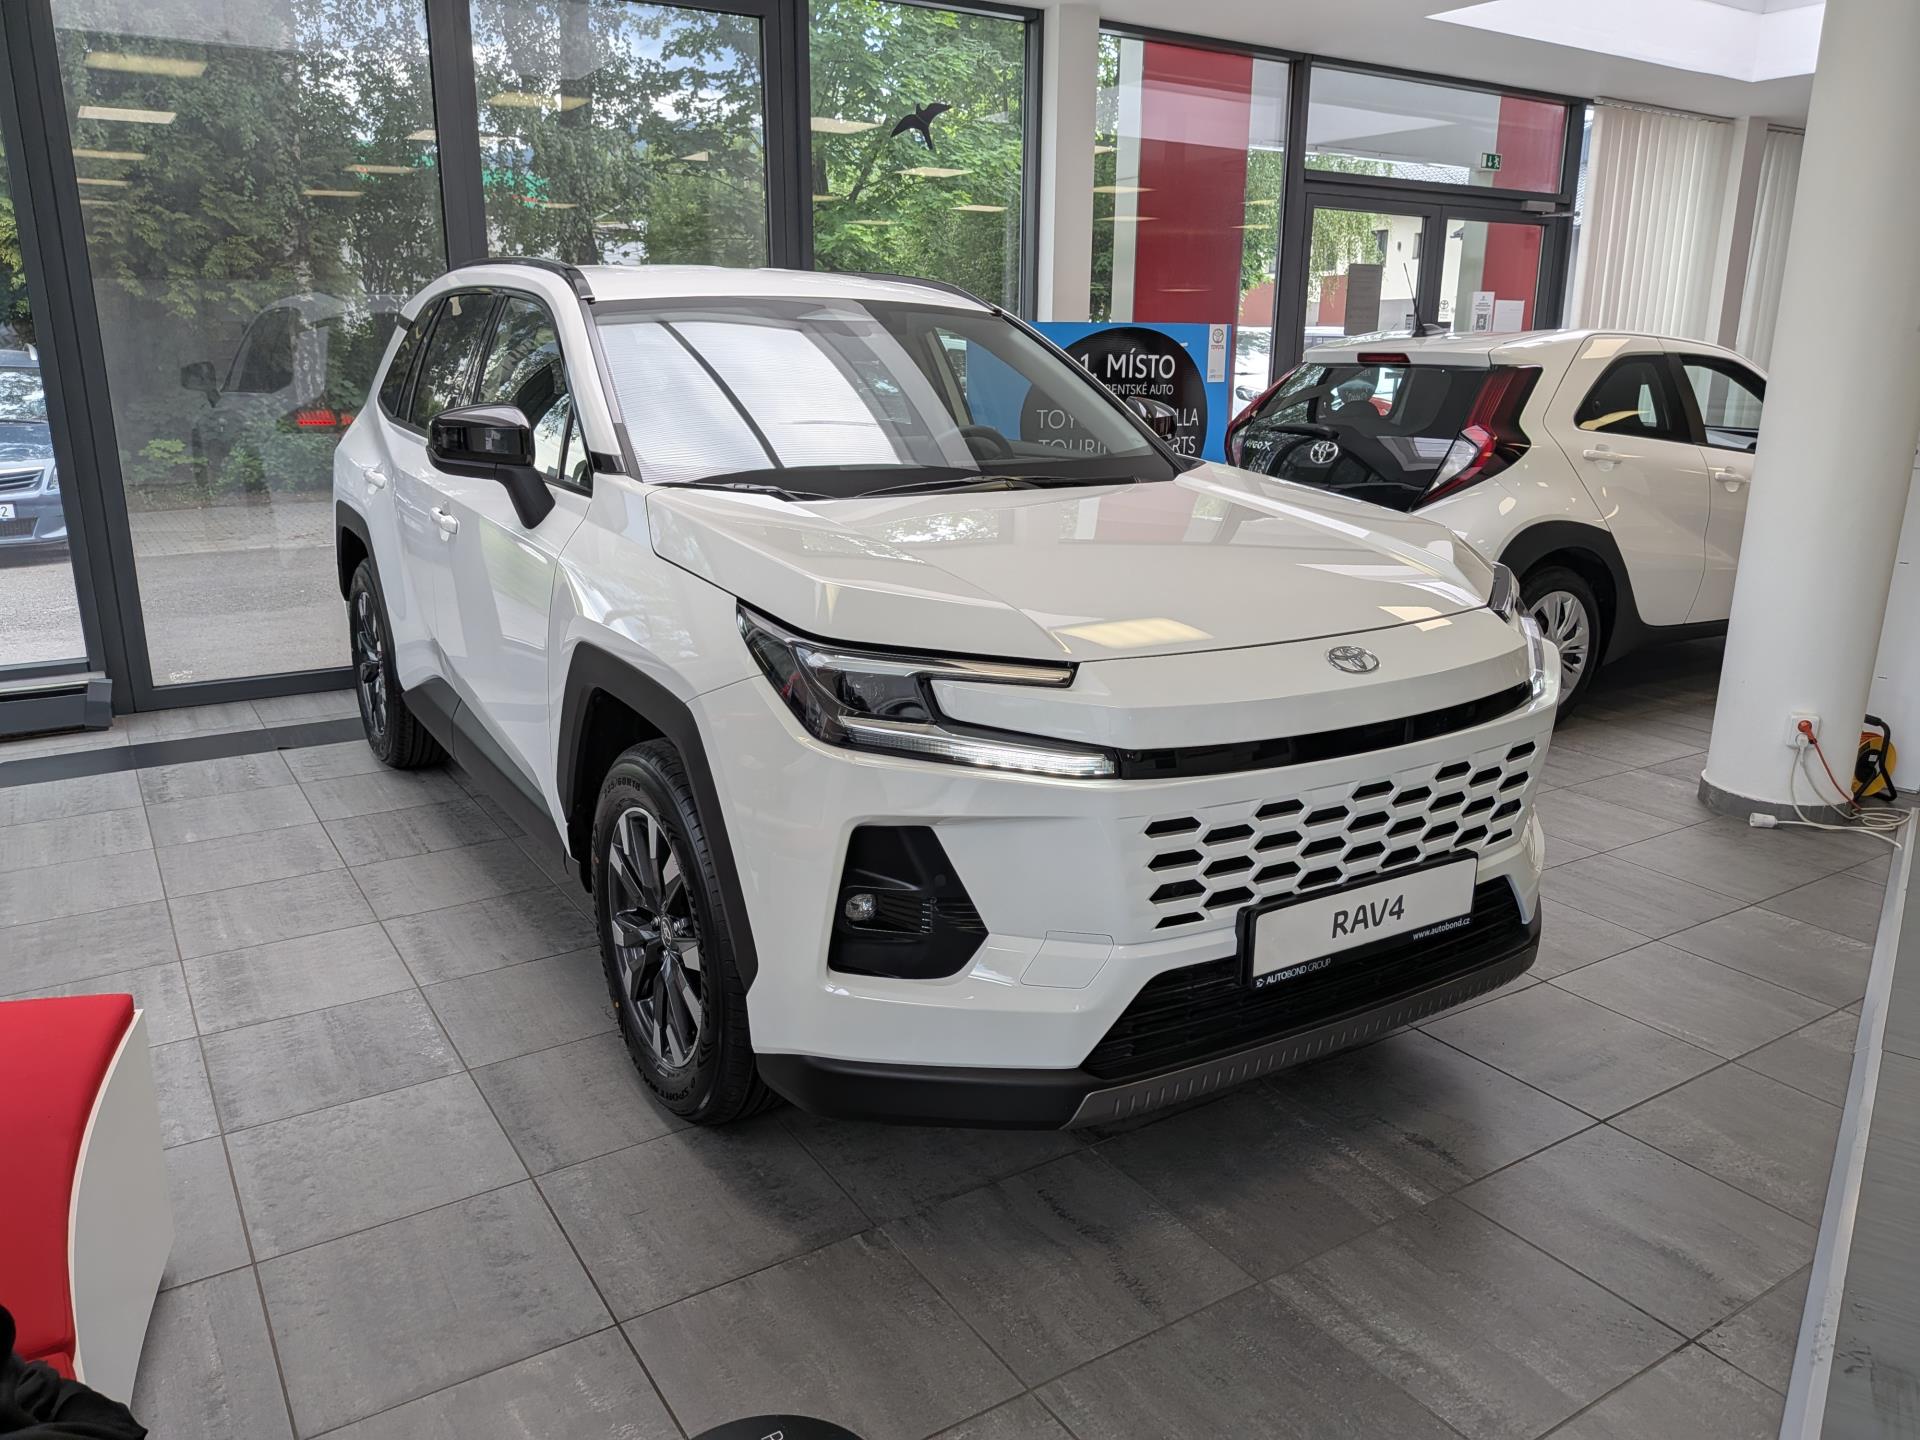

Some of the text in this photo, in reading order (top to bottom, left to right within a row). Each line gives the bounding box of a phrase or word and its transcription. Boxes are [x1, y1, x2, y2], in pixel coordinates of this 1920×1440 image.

[1106, 347, 1176, 379] MÍSTO
[1149, 384, 1174, 396] AUTO
[1332, 894, 1405, 939] RAV4
[1412, 917, 1471, 940] www.autobond.cz
[1266, 957, 1332, 985] AUTOBOND GROUP
